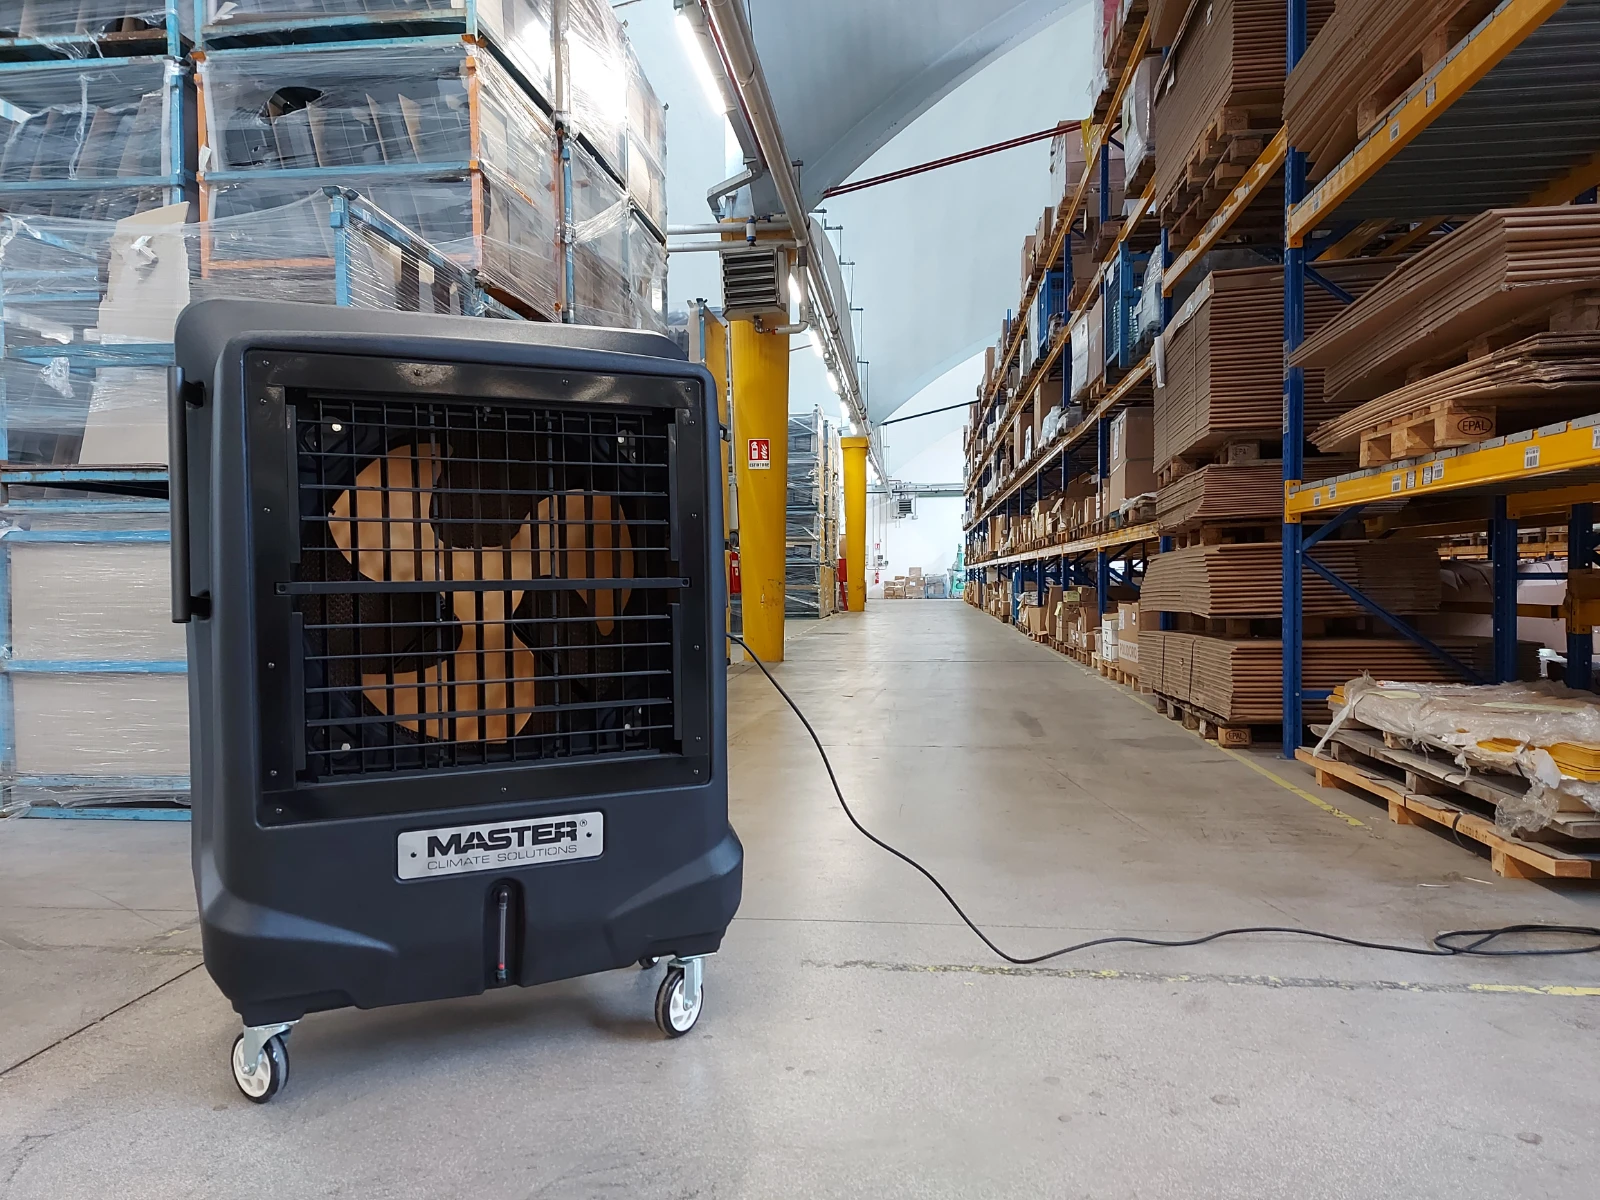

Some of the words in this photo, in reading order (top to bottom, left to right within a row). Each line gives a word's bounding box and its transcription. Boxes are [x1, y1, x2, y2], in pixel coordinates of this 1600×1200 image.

[1462, 420, 1488, 431] EPAL
[427, 855, 490, 870] CLIMATE
[497, 845, 577, 862] SOLUTIONS
